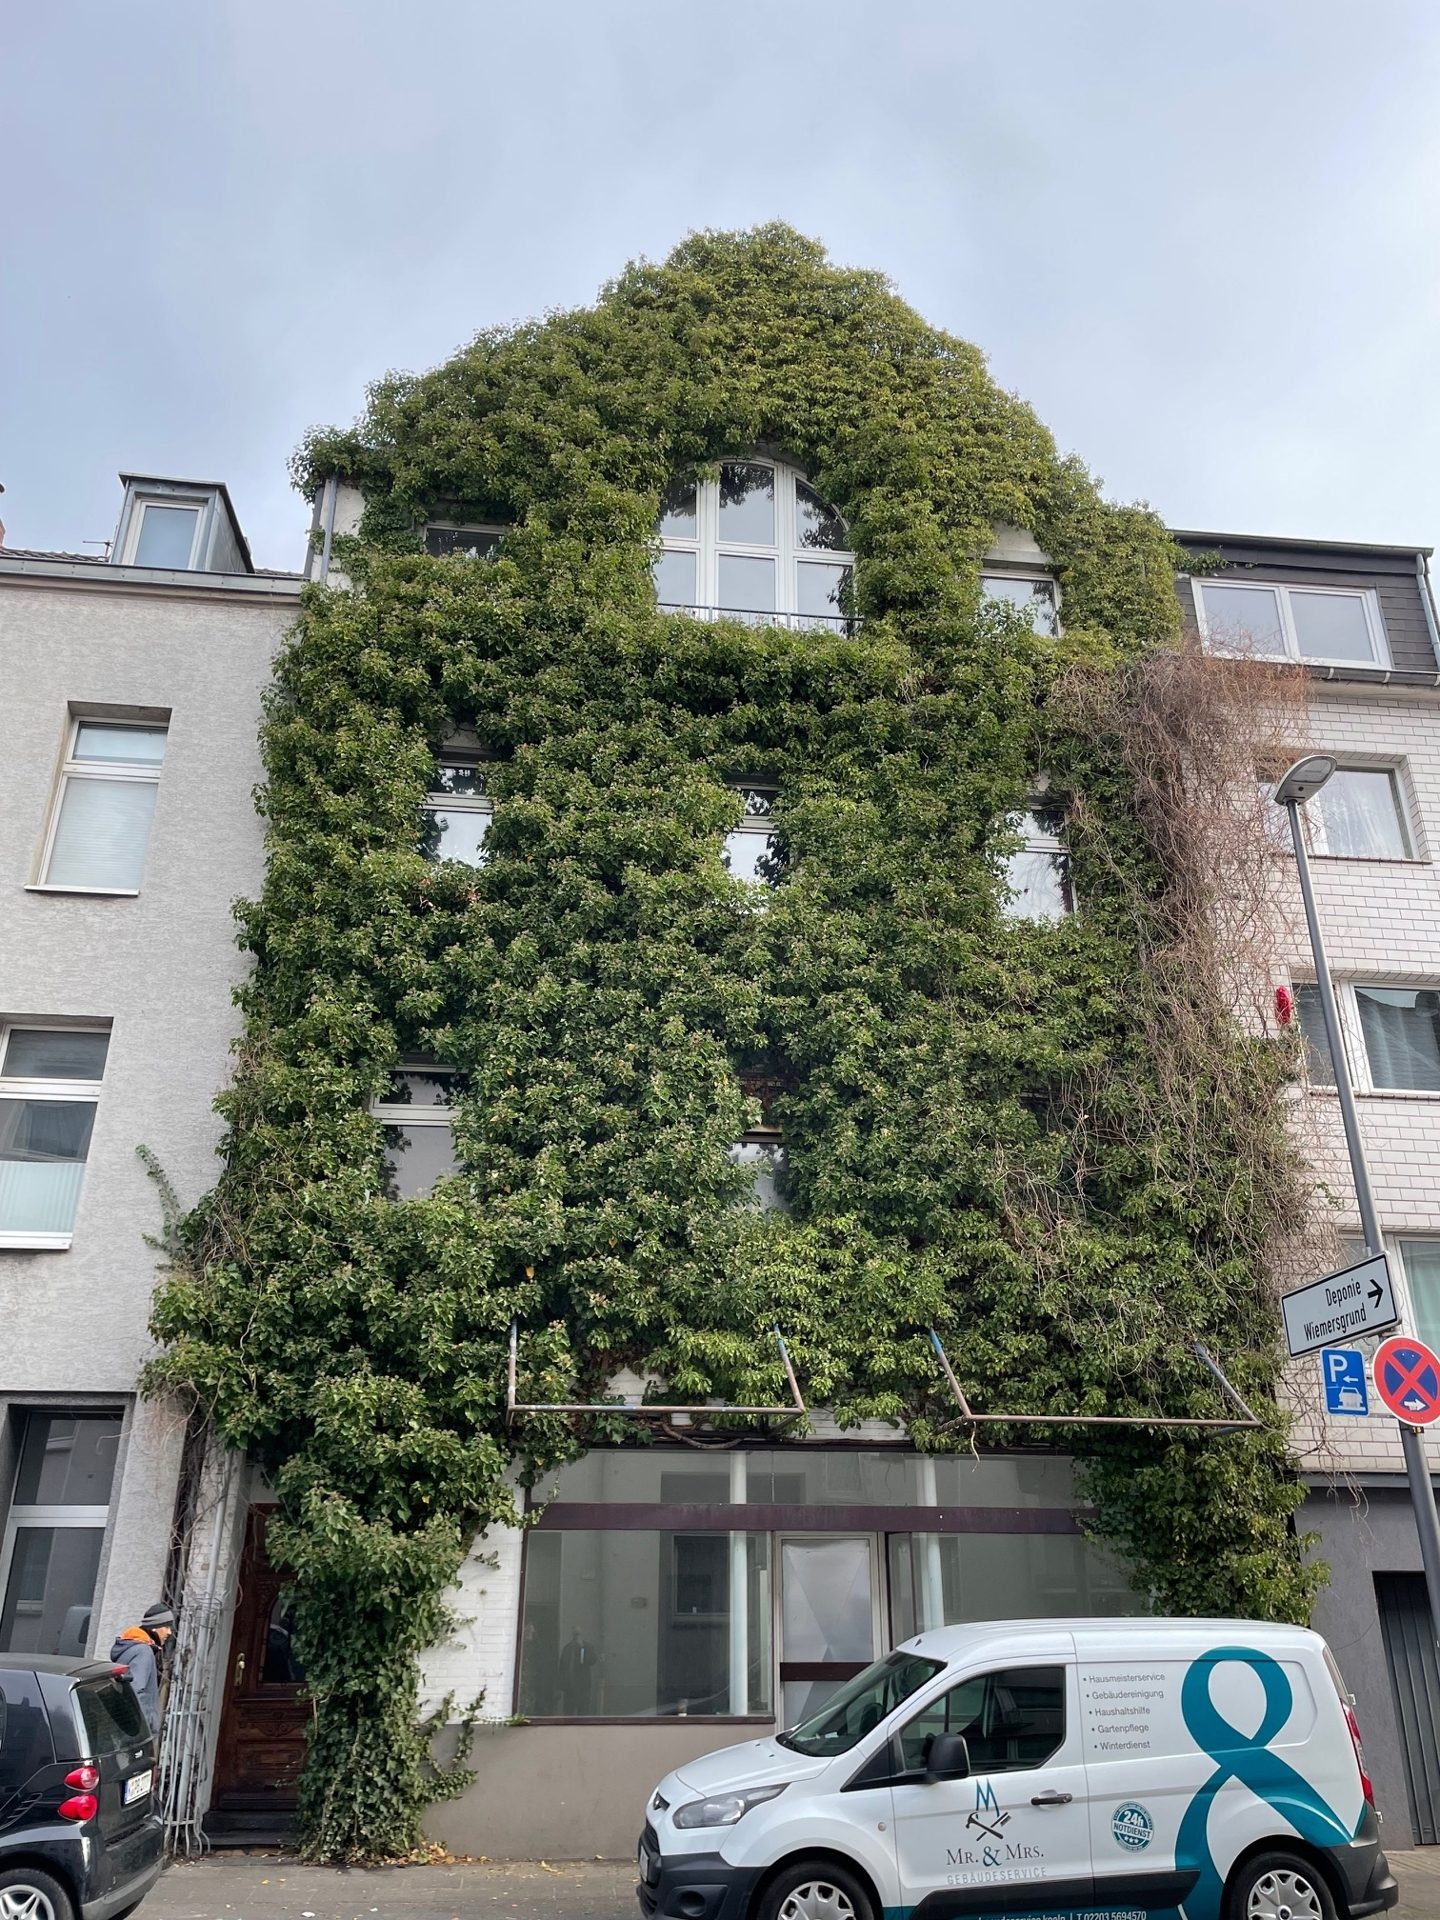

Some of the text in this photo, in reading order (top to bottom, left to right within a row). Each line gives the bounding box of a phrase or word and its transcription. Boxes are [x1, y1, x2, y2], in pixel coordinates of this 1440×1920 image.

[1325, 1278, 1361, 1306] Deponie
[1304, 1303, 1367, 1341] Wiemersgrund
[1328, 1354, 1348, 1383] P
[1088, 1673, 1166, 1683] Hausmeisterservice
[1091, 1690, 1164, 1700] Gebäudereinigung
[1094, 1706, 1151, 1716] Haushaltshilfe
[1097, 1723, 1149, 1734] Gartenpflege
[1099, 1741, 1151, 1750] Winterdienst
[1123, 1810, 1144, 1827] 24h
[1113, 1822, 1151, 1839] NOTDIENST
[982, 1845, 1002, 1867] &
[1083, 1912, 1110, 1920] 02203
[1111, 1910, 1147, 1920] 5694570
